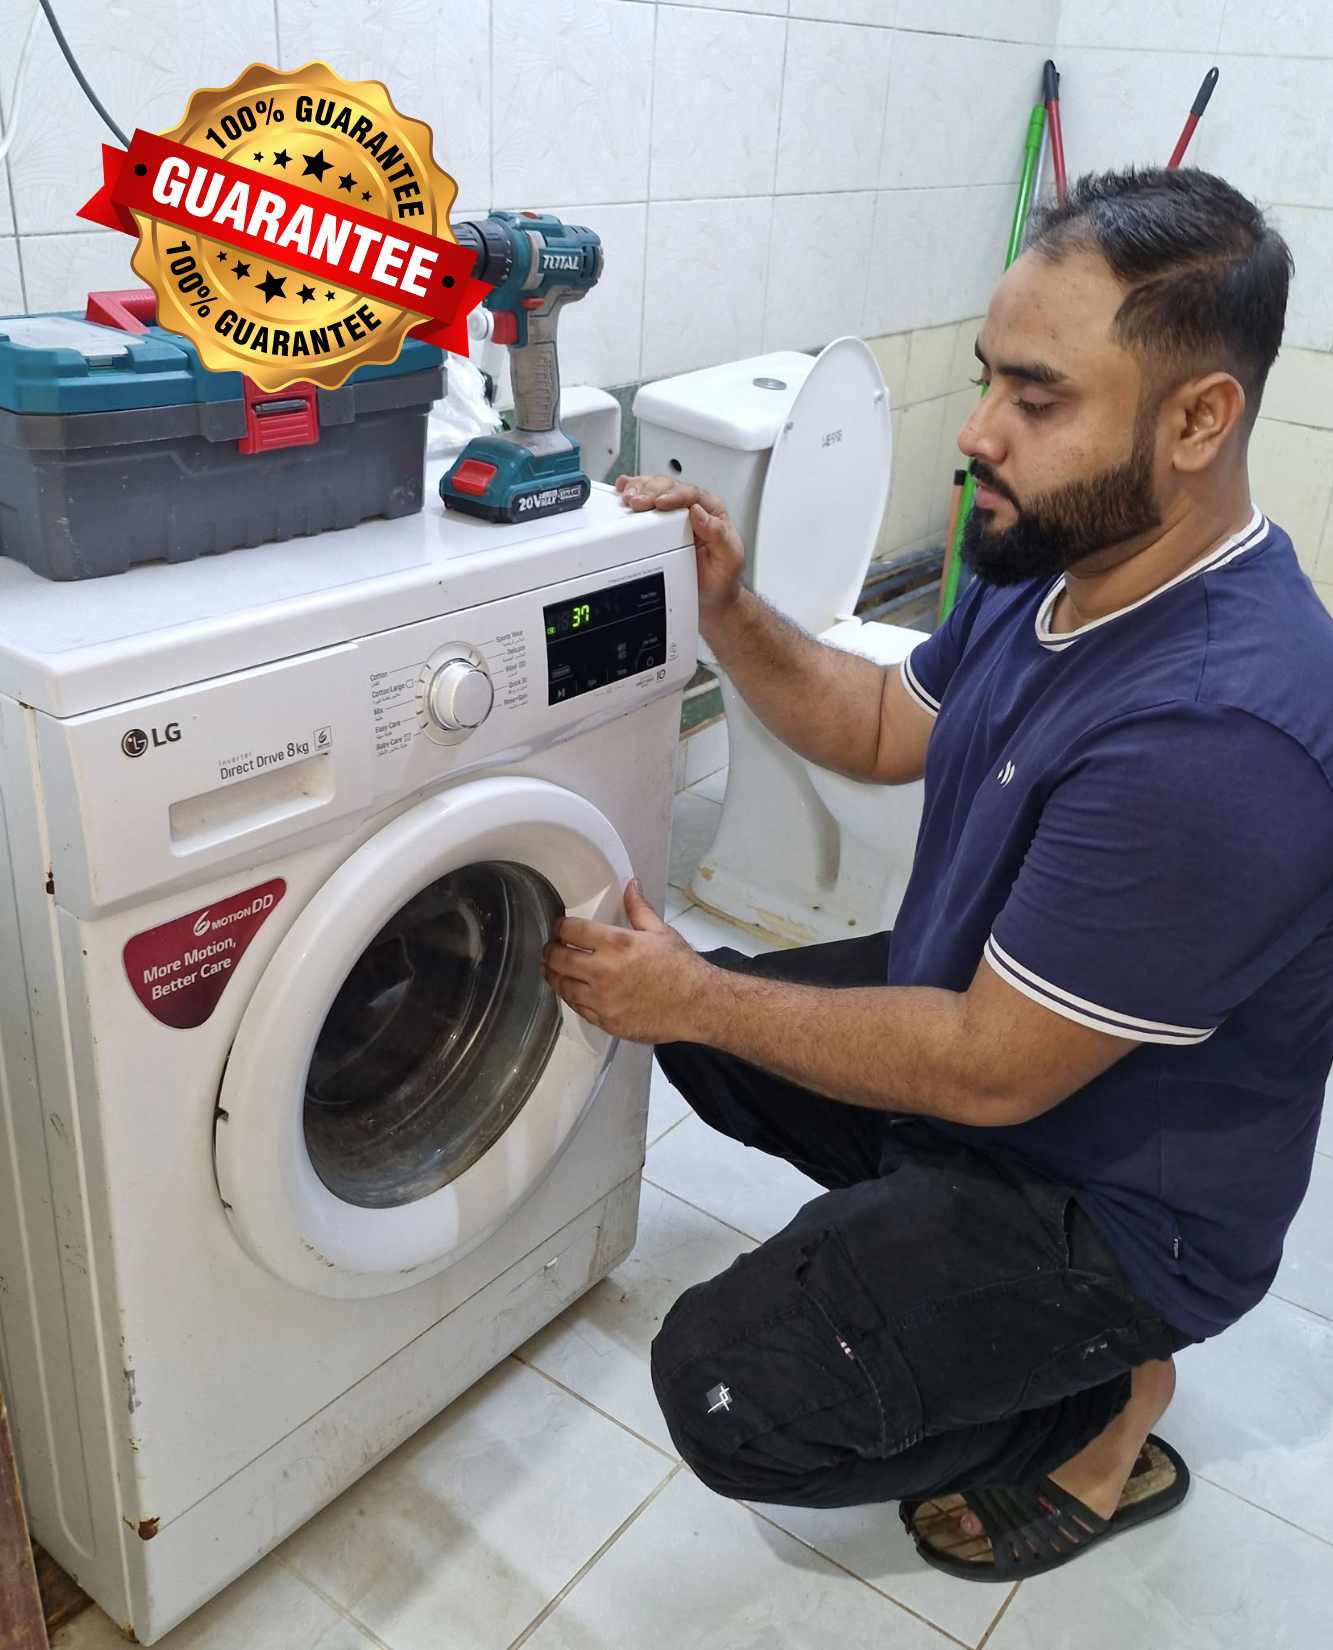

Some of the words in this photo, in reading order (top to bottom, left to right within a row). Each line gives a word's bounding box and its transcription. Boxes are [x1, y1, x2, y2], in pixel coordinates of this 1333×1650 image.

[542, 254, 579, 270] TOTAL
[518, 494, 541, 511] 20V
[572, 604, 590, 628] 37
[496, 634, 511, 643] Sports
[511, 630, 523, 638] Wear
[507, 645, 525, 655] Delicate
[505, 663, 517, 672] Wool
[370, 672, 388, 682] Cotton
[508, 679, 521, 688] Quick
[371, 688, 389, 698] Cotton
[389, 683, 405, 693] Large
[375, 724, 388, 733] Easy
[388, 720, 401, 729] Care
[151, 722, 182, 747] LG
[376, 742, 389, 751] Baby
[390, 737, 403, 746] Care
[218, 751, 252, 766] Inverter
[220, 760, 255, 780] Direct
[256, 750, 285, 768] Drive
[143, 959, 182, 984] More
[184, 937, 236, 966] Motion,
[151, 972, 198, 1001] Better
[200, 957, 232, 979] Care
